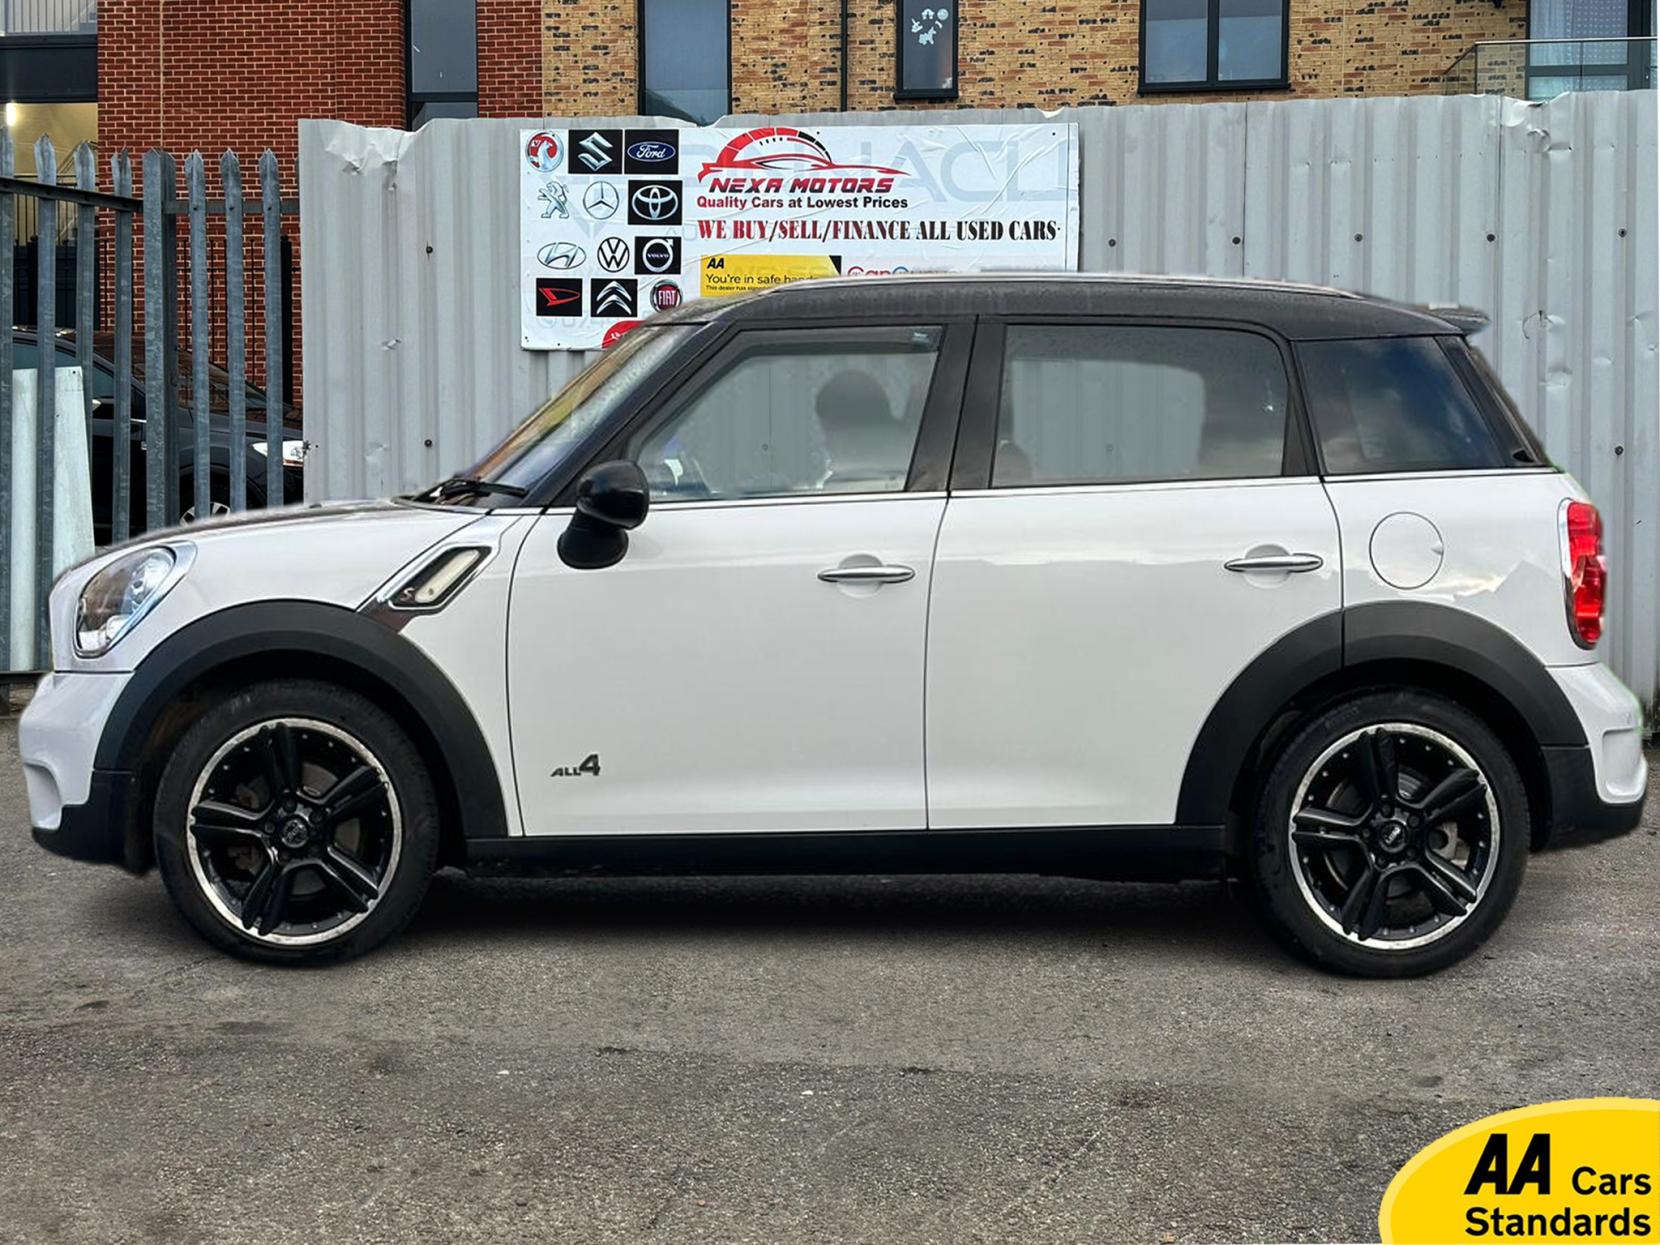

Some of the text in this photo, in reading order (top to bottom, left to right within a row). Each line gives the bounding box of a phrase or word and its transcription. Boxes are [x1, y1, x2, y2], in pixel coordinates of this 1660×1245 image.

[636, 144, 666, 159] Ford
[708, 177, 895, 194] NEXA MOTORS
[696, 195, 909, 211] Quality Cars at Lowest Prices
[697, 219, 727, 240] WE
[733, 219, 911, 243] BUY/SELL/FINANCE
[915, 220, 951, 241] ALL
[956, 220, 1004, 241] USED
[1008, 220, 1057, 241] CARS
[706, 257, 725, 269] AA
[705, 273, 742, 285] You're
[743, 273, 755, 285] in
[757, 273, 782, 285] safe
[658, 290, 677, 306] FIAT
